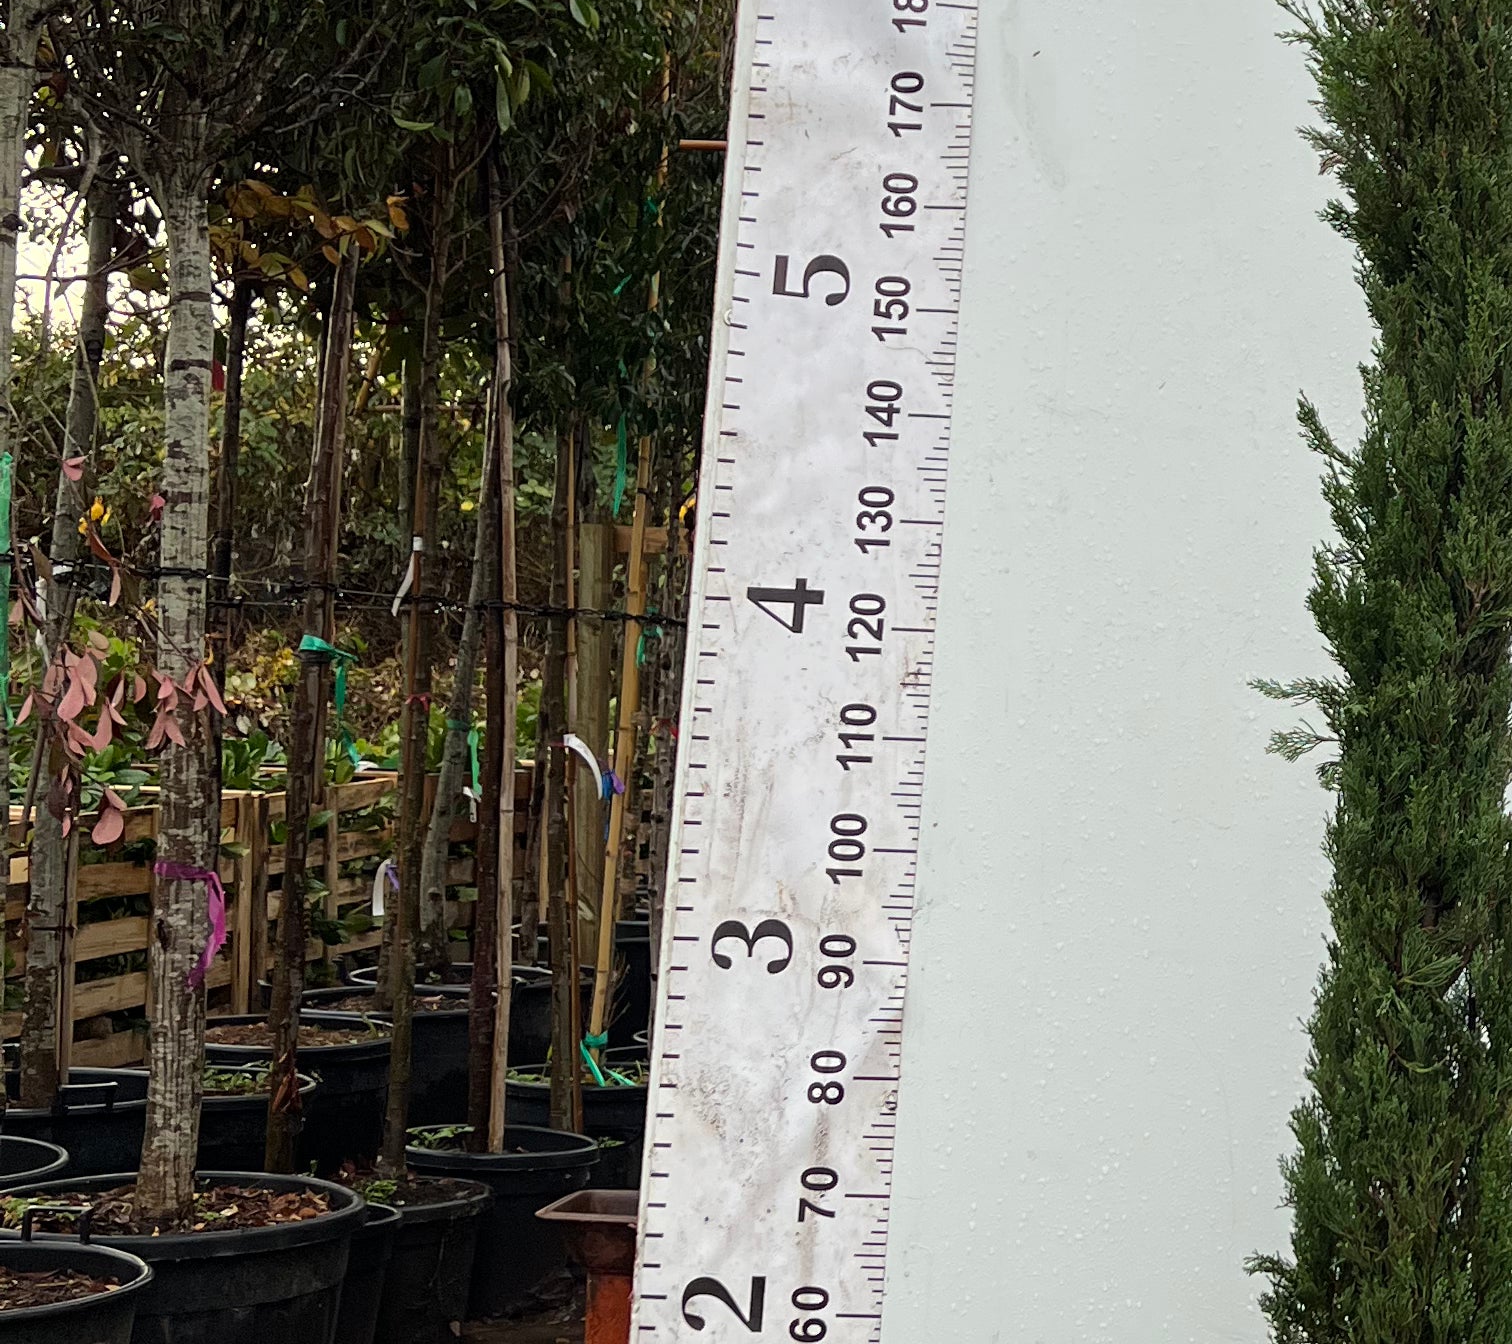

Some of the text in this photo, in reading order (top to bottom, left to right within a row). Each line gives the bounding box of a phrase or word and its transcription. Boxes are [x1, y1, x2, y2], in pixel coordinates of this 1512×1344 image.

[887, 71, 925, 138] 170
[879, 173, 919, 239] 160
[772, 255, 850, 307] 5
[871, 276, 911, 342] 150
[862, 380, 903, 448] 140
[854, 486, 895, 554] 130
[746, 577, 825, 634] 4
[845, 593, 886, 663] 120
[835, 703, 877, 771] 110
[825, 813, 868, 885] 100
[711, 919, 793, 975] 3
[817, 934, 857, 989] 90
[807, 1050, 847, 1106] 80
[797, 1166, 839, 1223] 70
[681, 1276, 767, 1333] 2
[789, 1286, 829, 1343] 60
